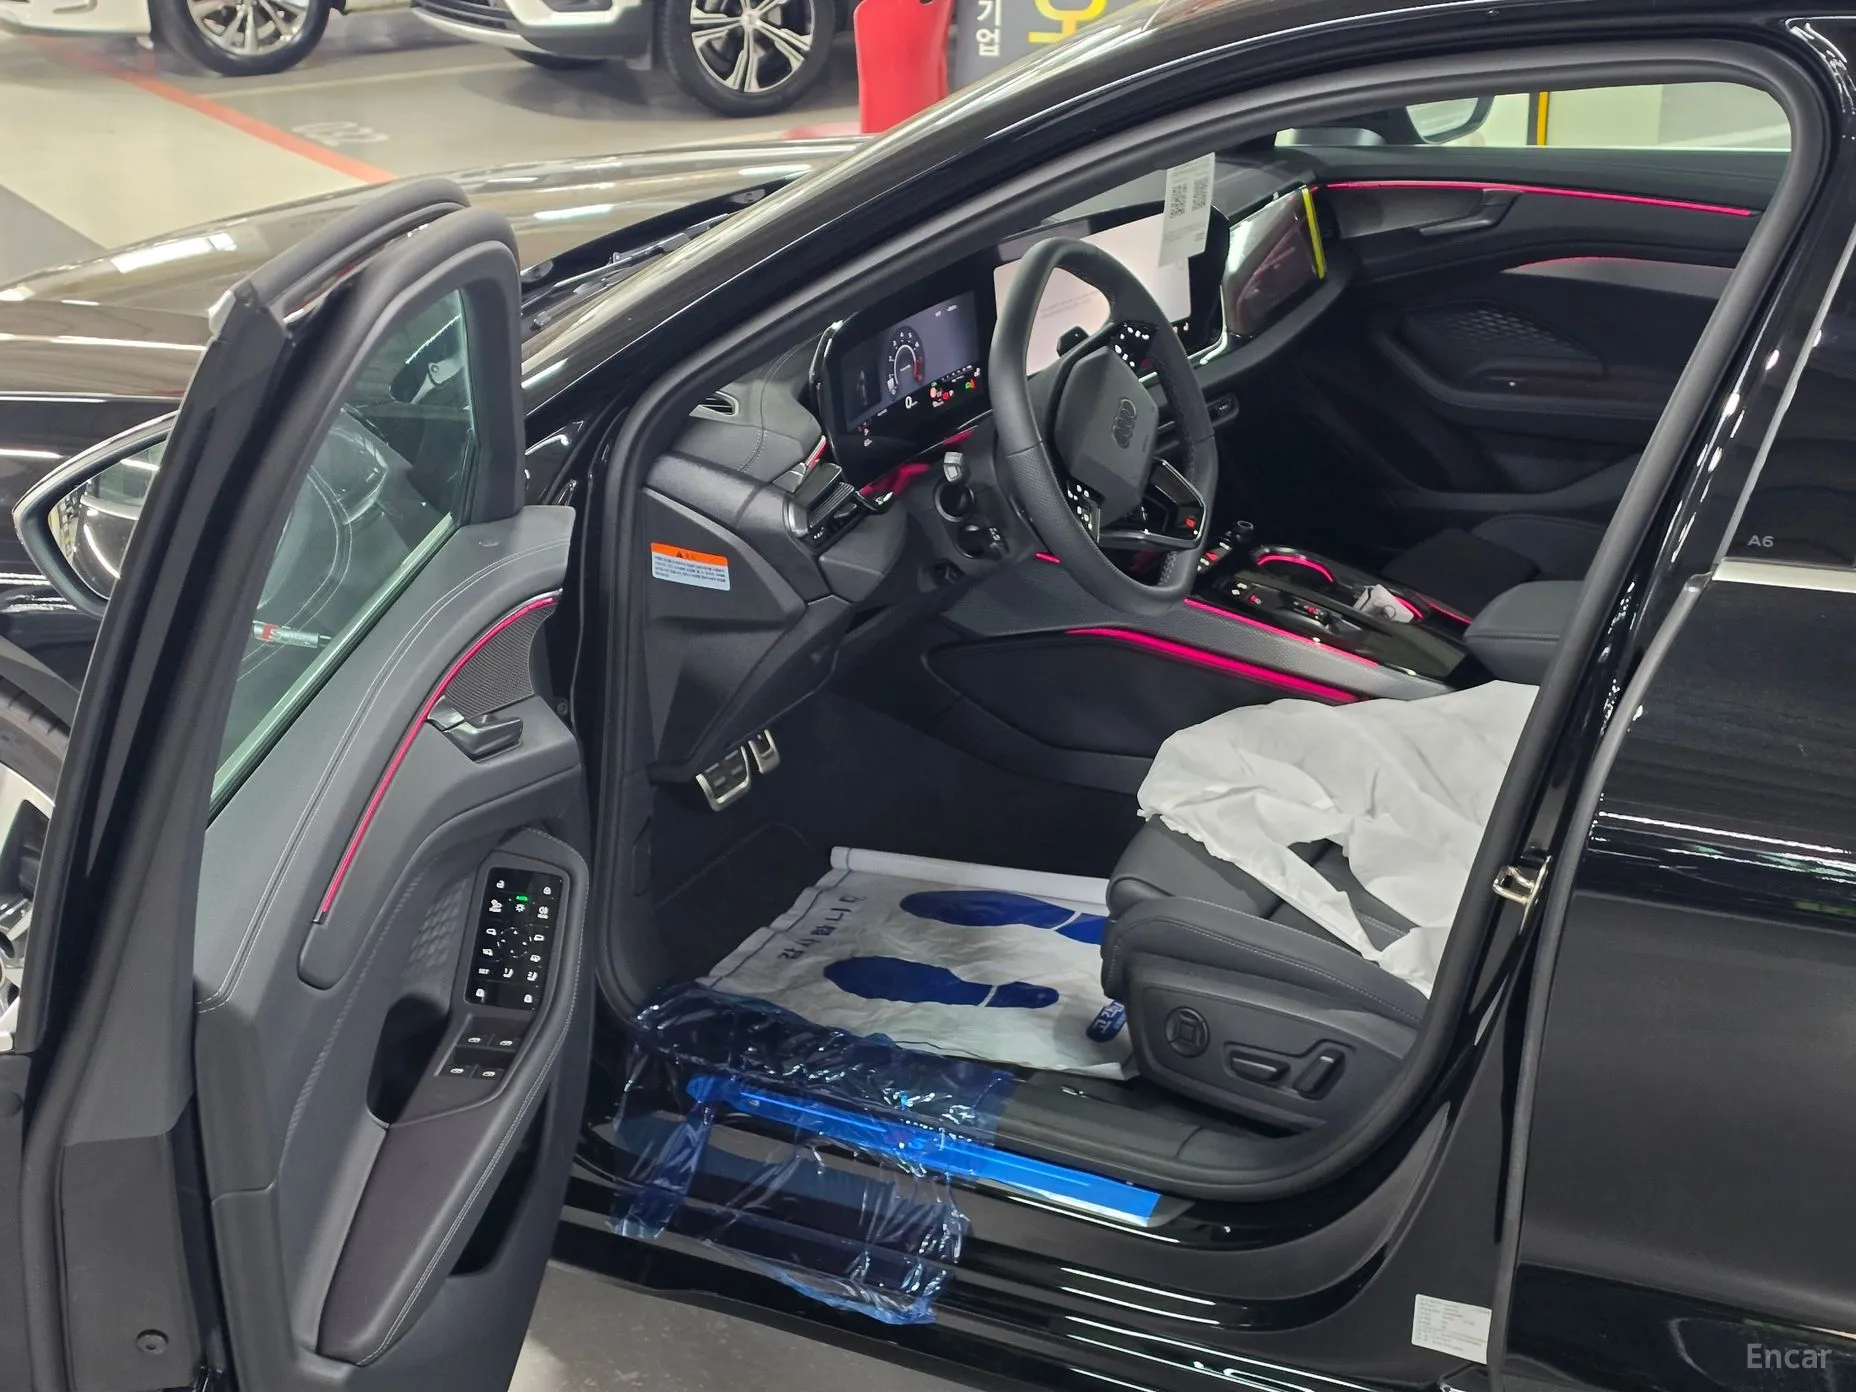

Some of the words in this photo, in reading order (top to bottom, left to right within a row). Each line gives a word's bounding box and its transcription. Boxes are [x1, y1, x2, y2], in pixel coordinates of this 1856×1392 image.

[976, 0, 1001, 57] 기업
[1747, 535, 1775, 548] A6
[777, 894, 868, 959] 감사합니다
